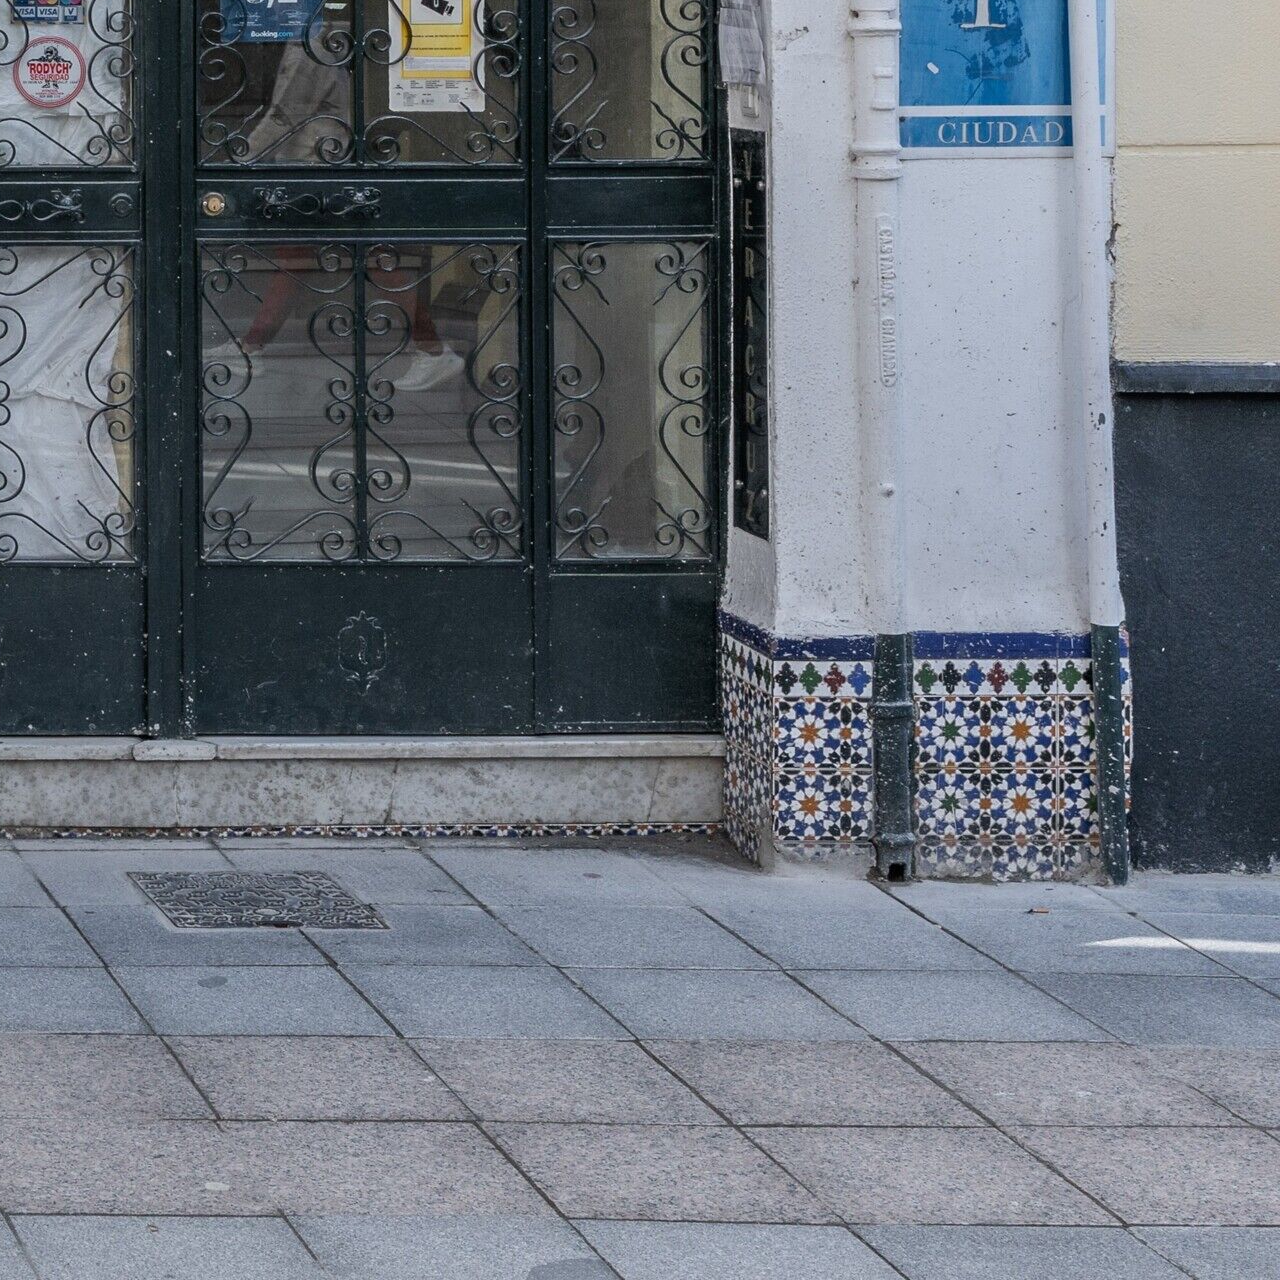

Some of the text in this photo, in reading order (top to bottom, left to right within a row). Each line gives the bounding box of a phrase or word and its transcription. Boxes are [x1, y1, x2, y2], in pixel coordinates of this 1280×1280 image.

[250, 30, 294, 38] Booking.com
[29, 63, 70, 74] RODYCH
[937, 120, 1065, 144] CIUDAD
